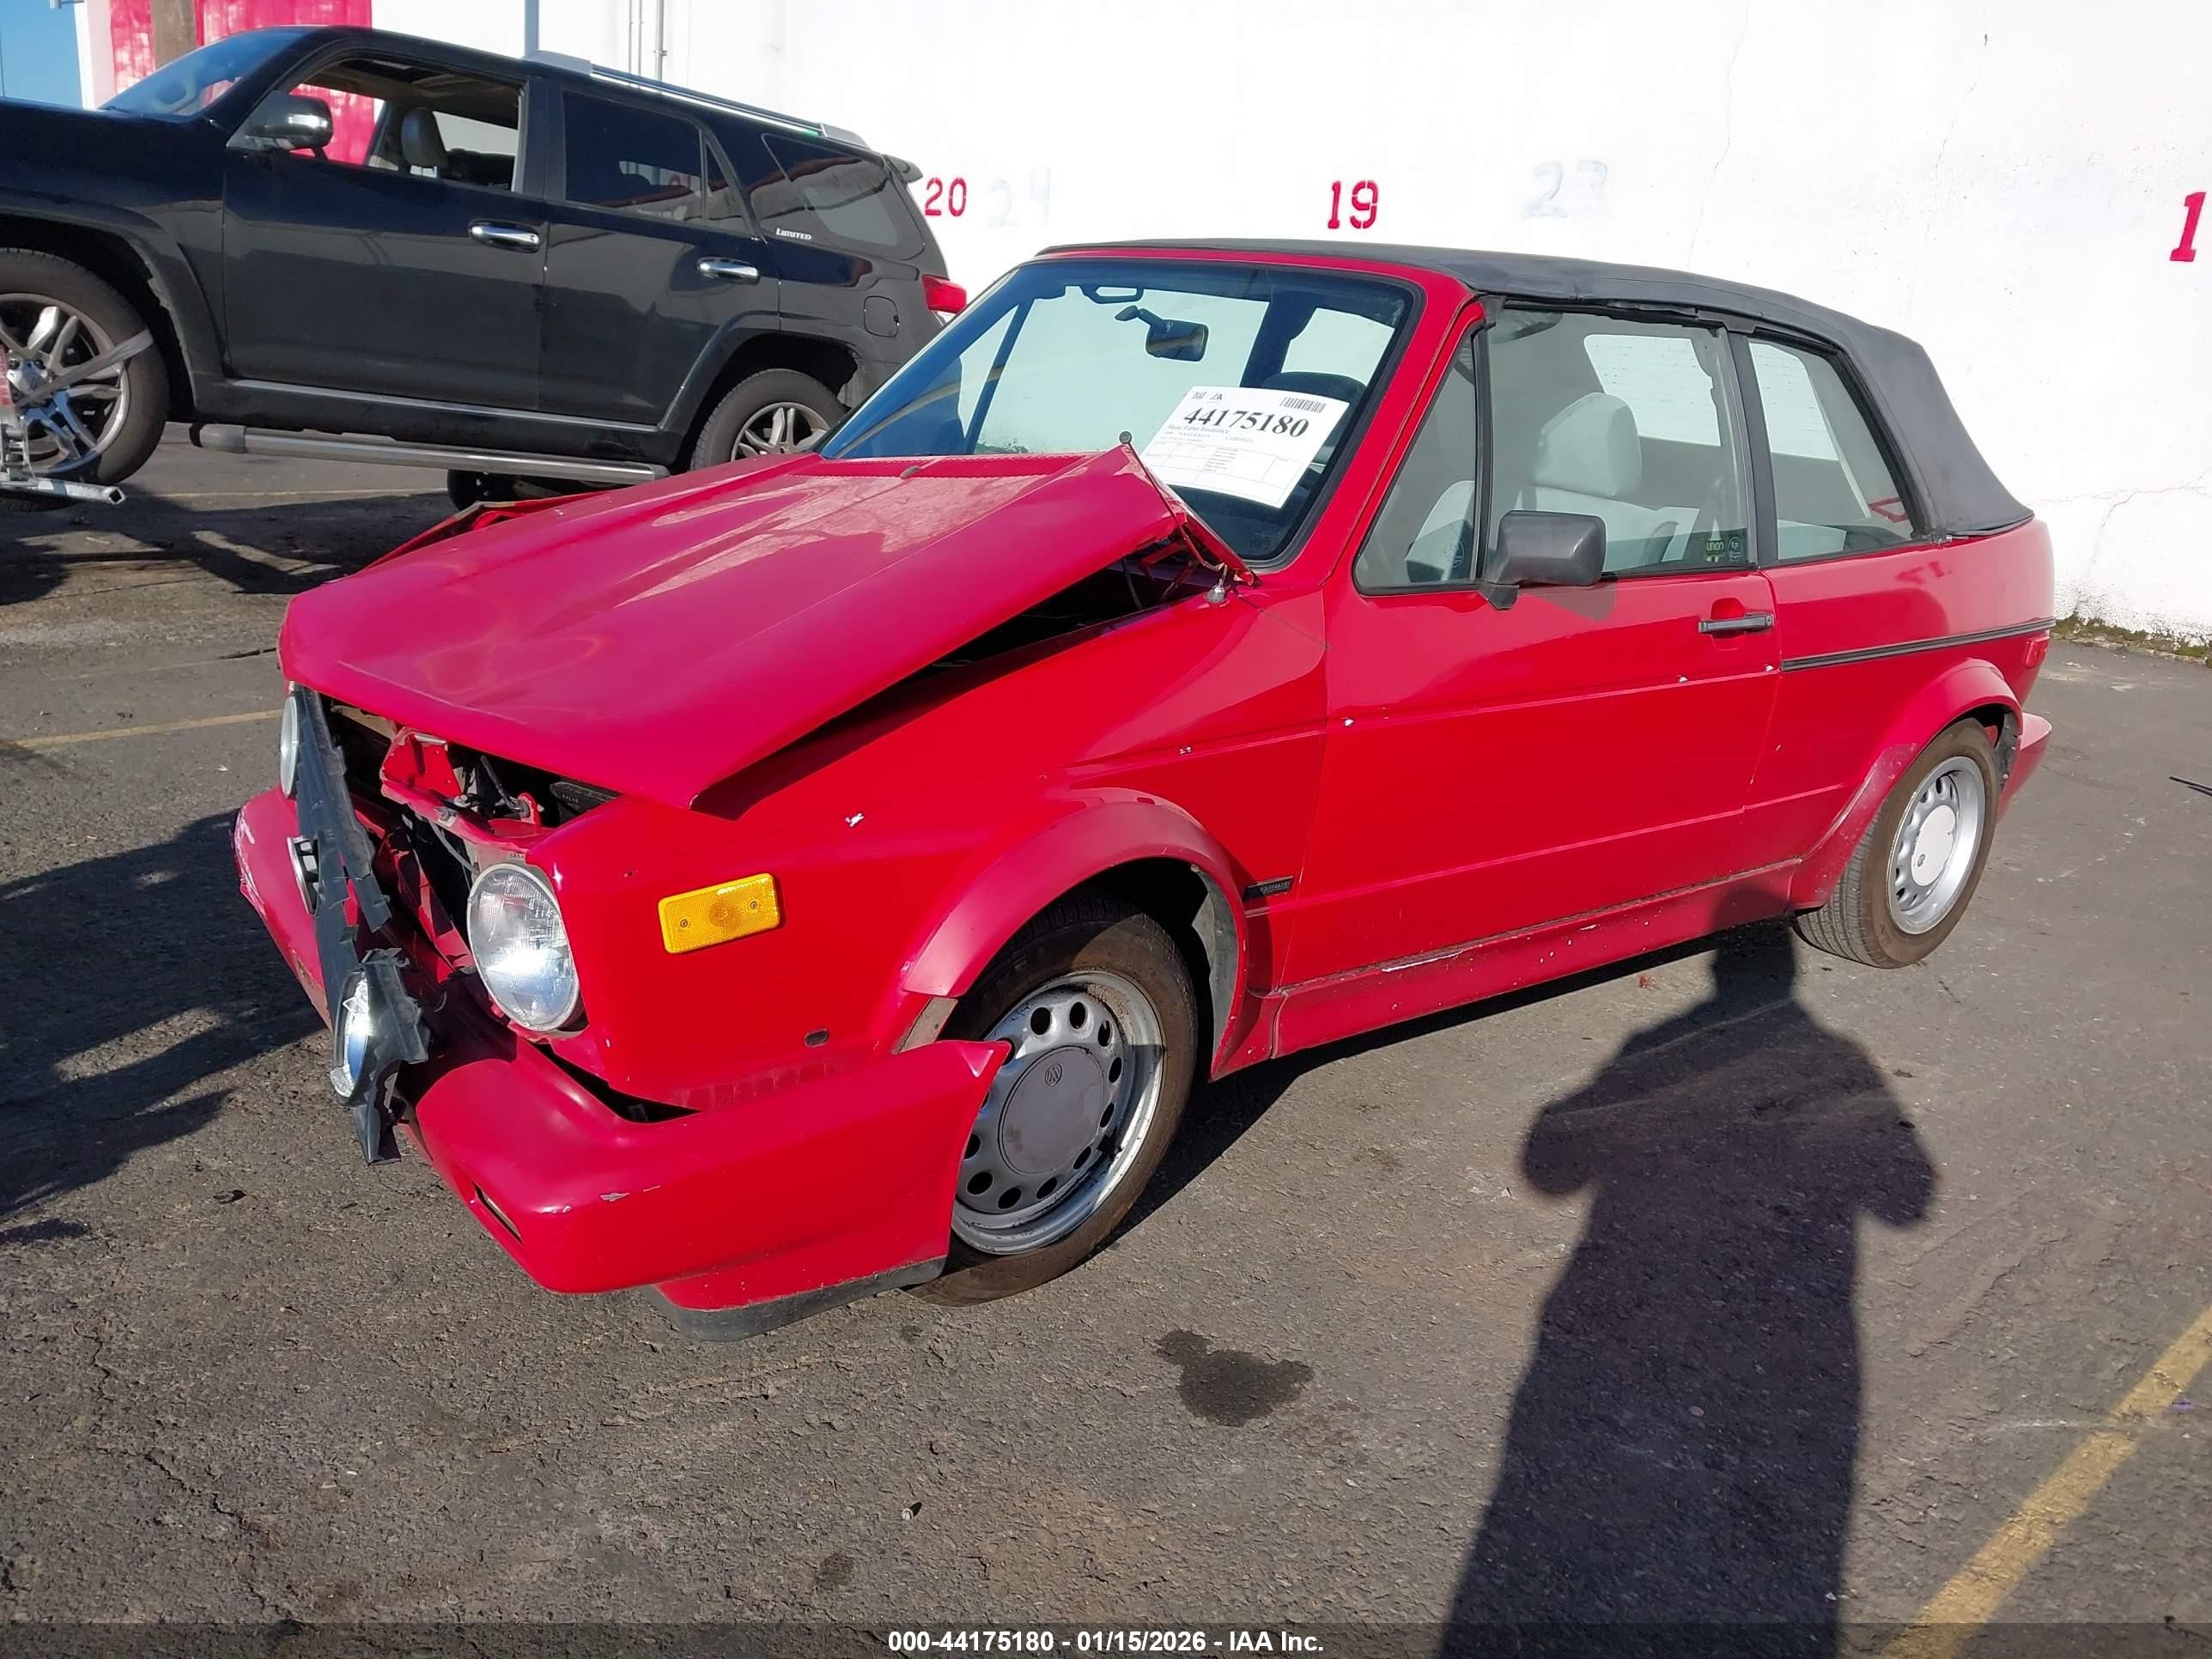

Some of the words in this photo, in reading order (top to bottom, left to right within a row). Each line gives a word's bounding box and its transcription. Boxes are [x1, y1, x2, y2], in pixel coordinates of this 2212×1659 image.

[925, 178, 966, 217] 20
[1328, 180, 1379, 230] 19
[2170, 191, 2206, 263] 1
[1183, 407, 1310, 438] 44175180
